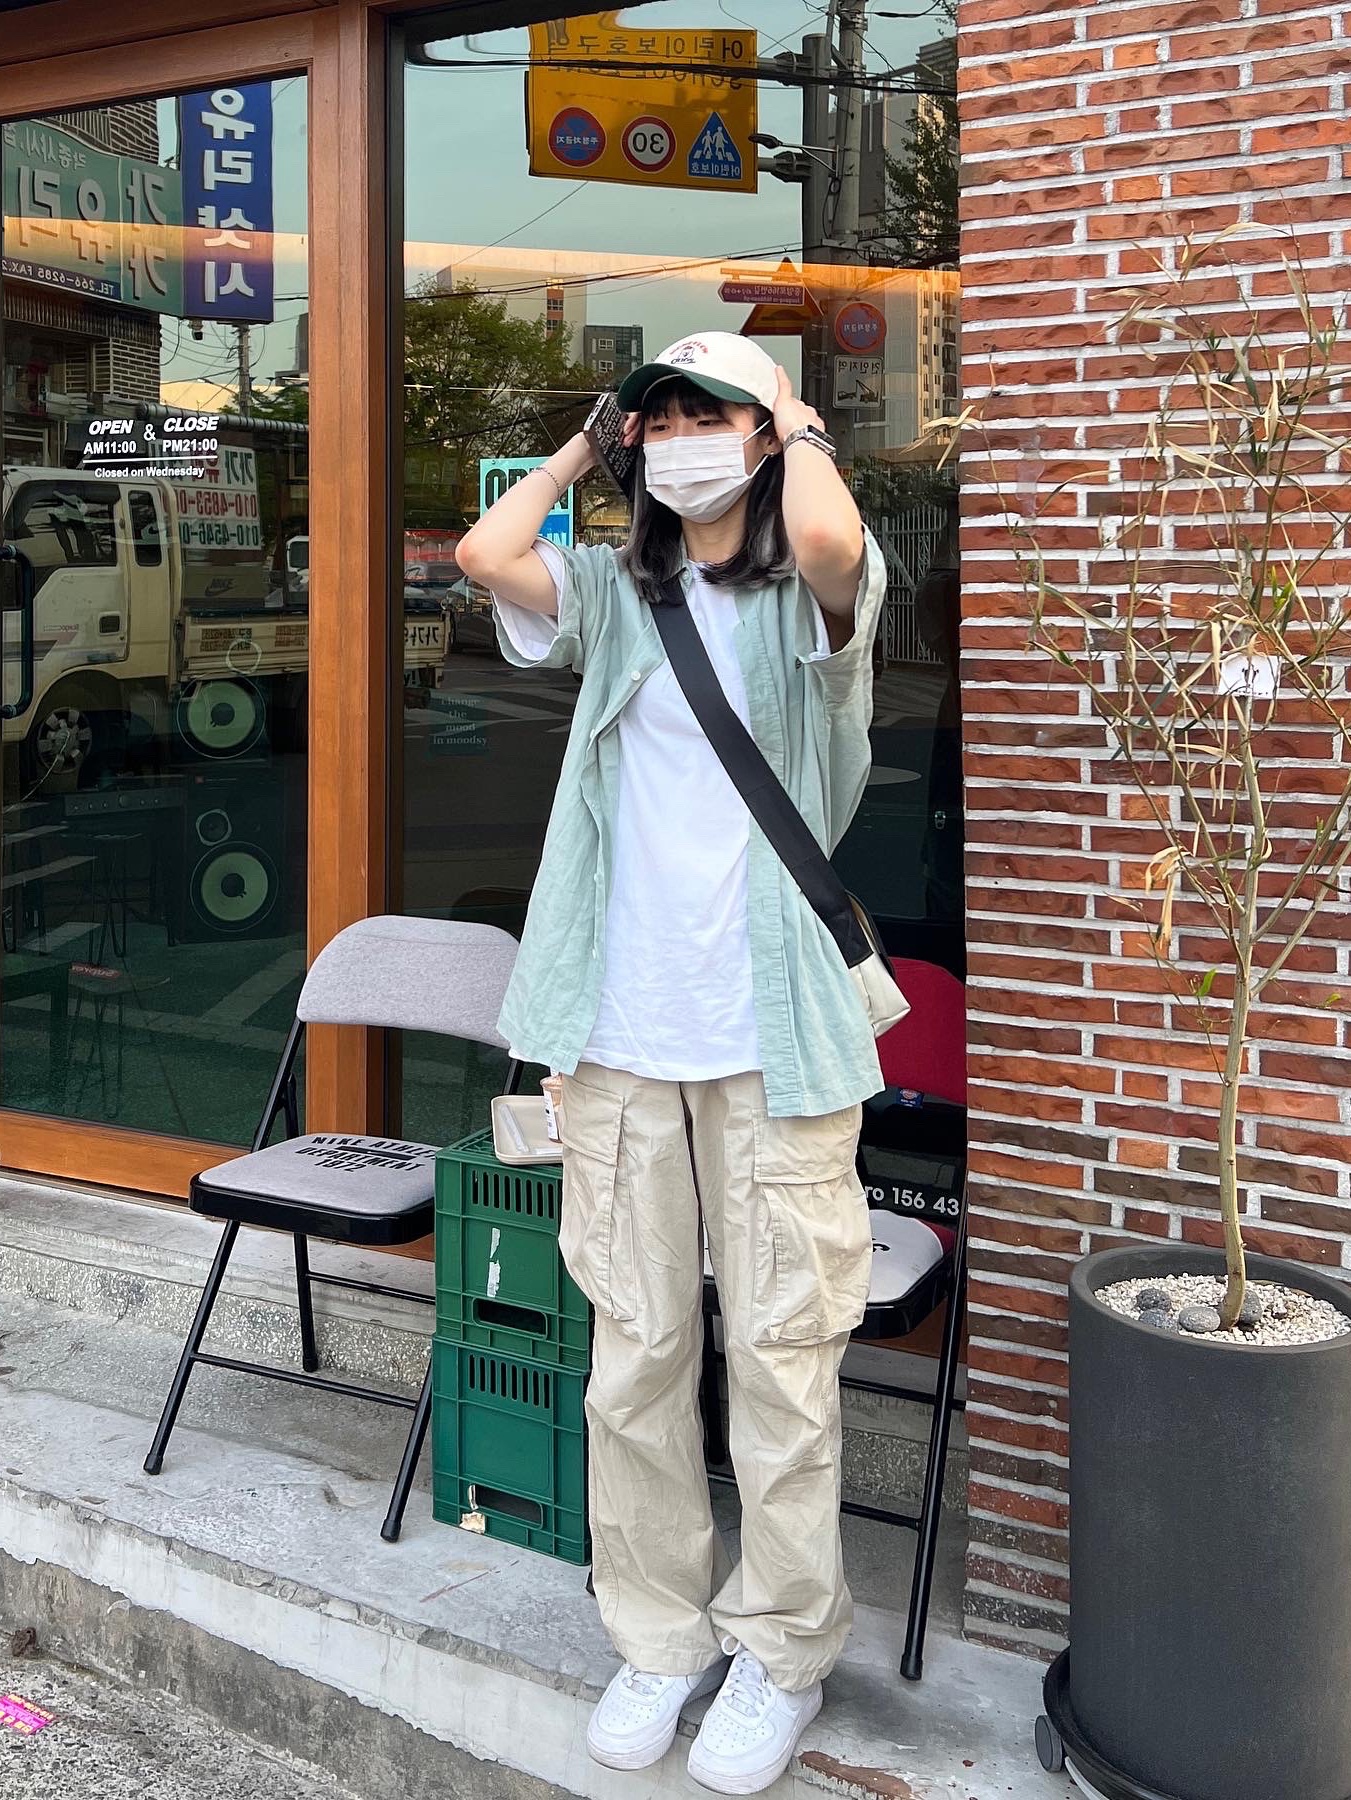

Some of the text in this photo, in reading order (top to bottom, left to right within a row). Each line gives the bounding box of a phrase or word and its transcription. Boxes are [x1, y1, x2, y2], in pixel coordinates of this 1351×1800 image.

[88, 416, 219, 441] OPEN & CLOSE
[83, 438, 218, 455] AM11:00 PM21:00
[94, 465, 205, 478] Closed on Wednesday
[311, 1136, 366, 1146] NIKE
[295, 1146, 426, 1172] DEPARTMENT
[892, 1187, 926, 1210] 156
[932, 1196, 960, 1217] 43
